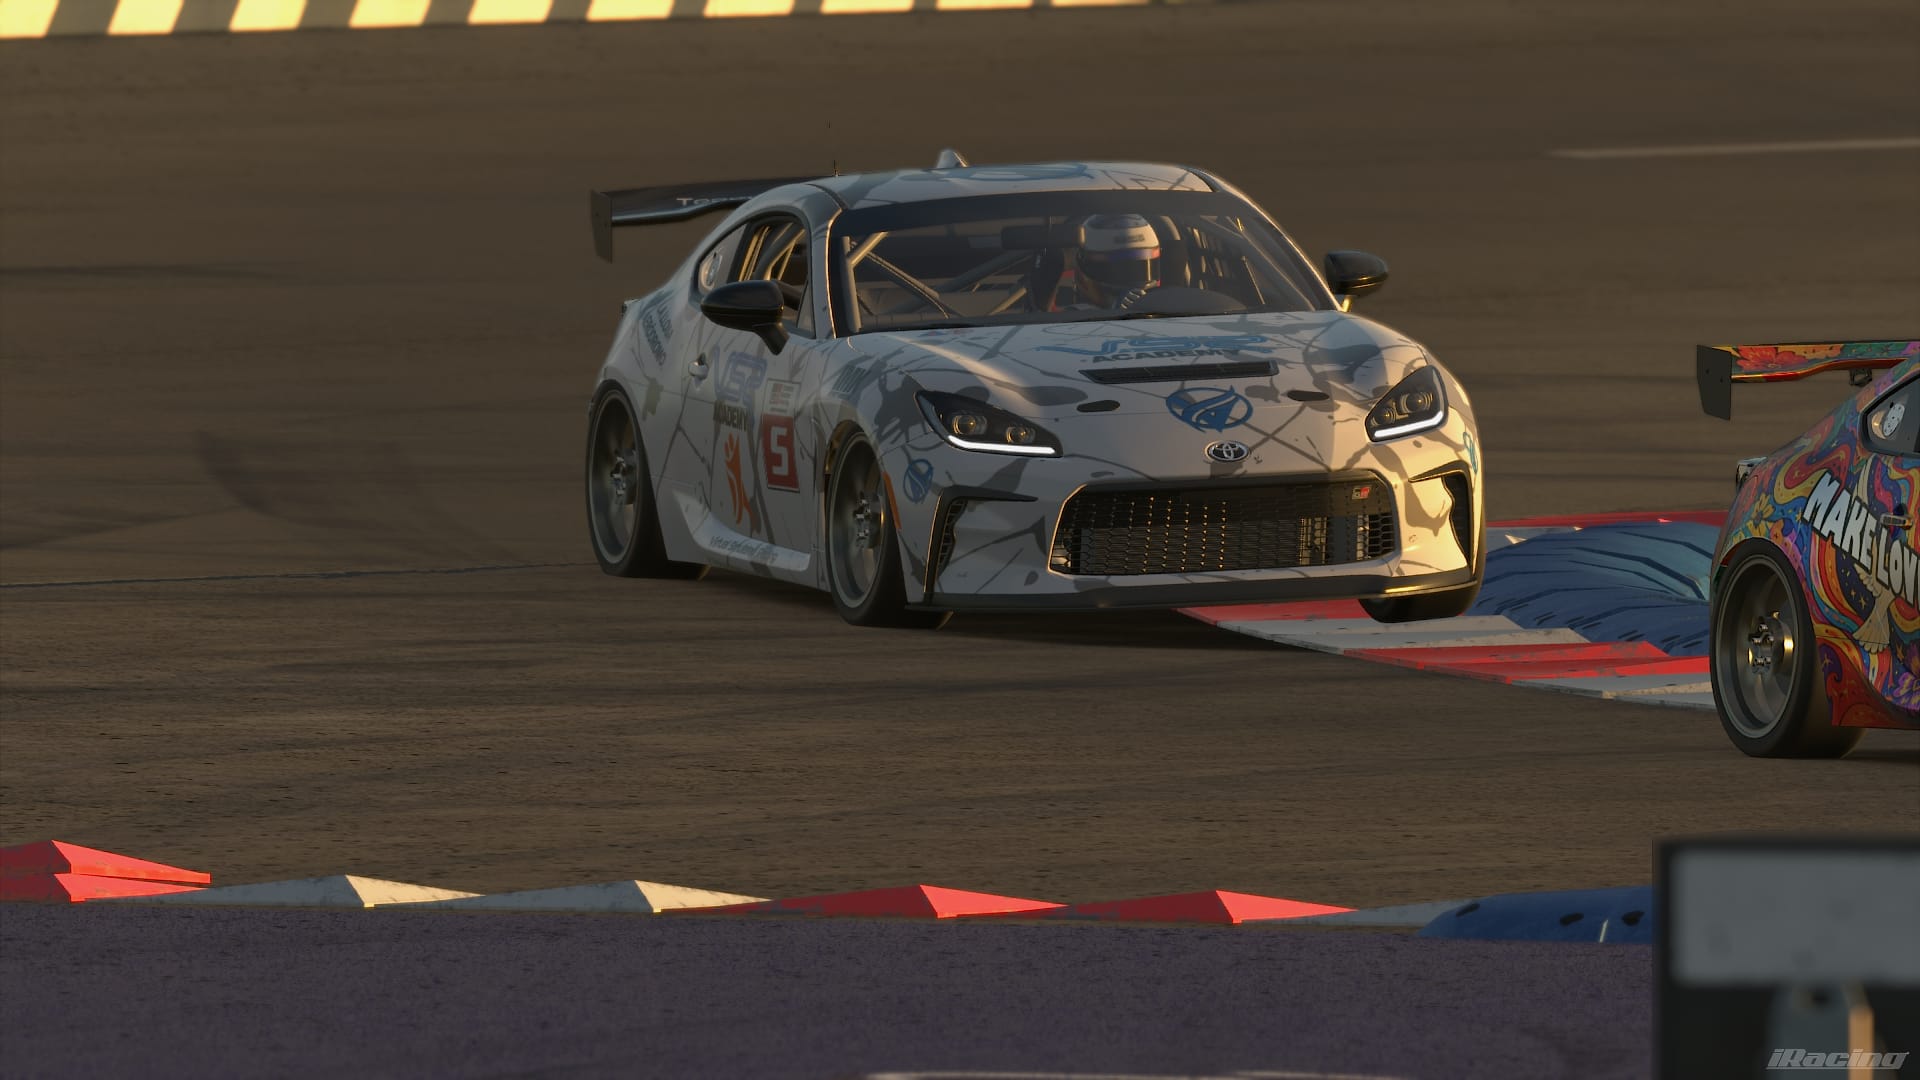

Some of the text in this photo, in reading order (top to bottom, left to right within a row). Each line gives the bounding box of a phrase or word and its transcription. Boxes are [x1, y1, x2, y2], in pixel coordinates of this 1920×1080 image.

[1092, 349, 1239, 363] ACADEMY
[770, 425, 789, 476] 5
[1803, 471, 1920, 607] MAKE LOV
